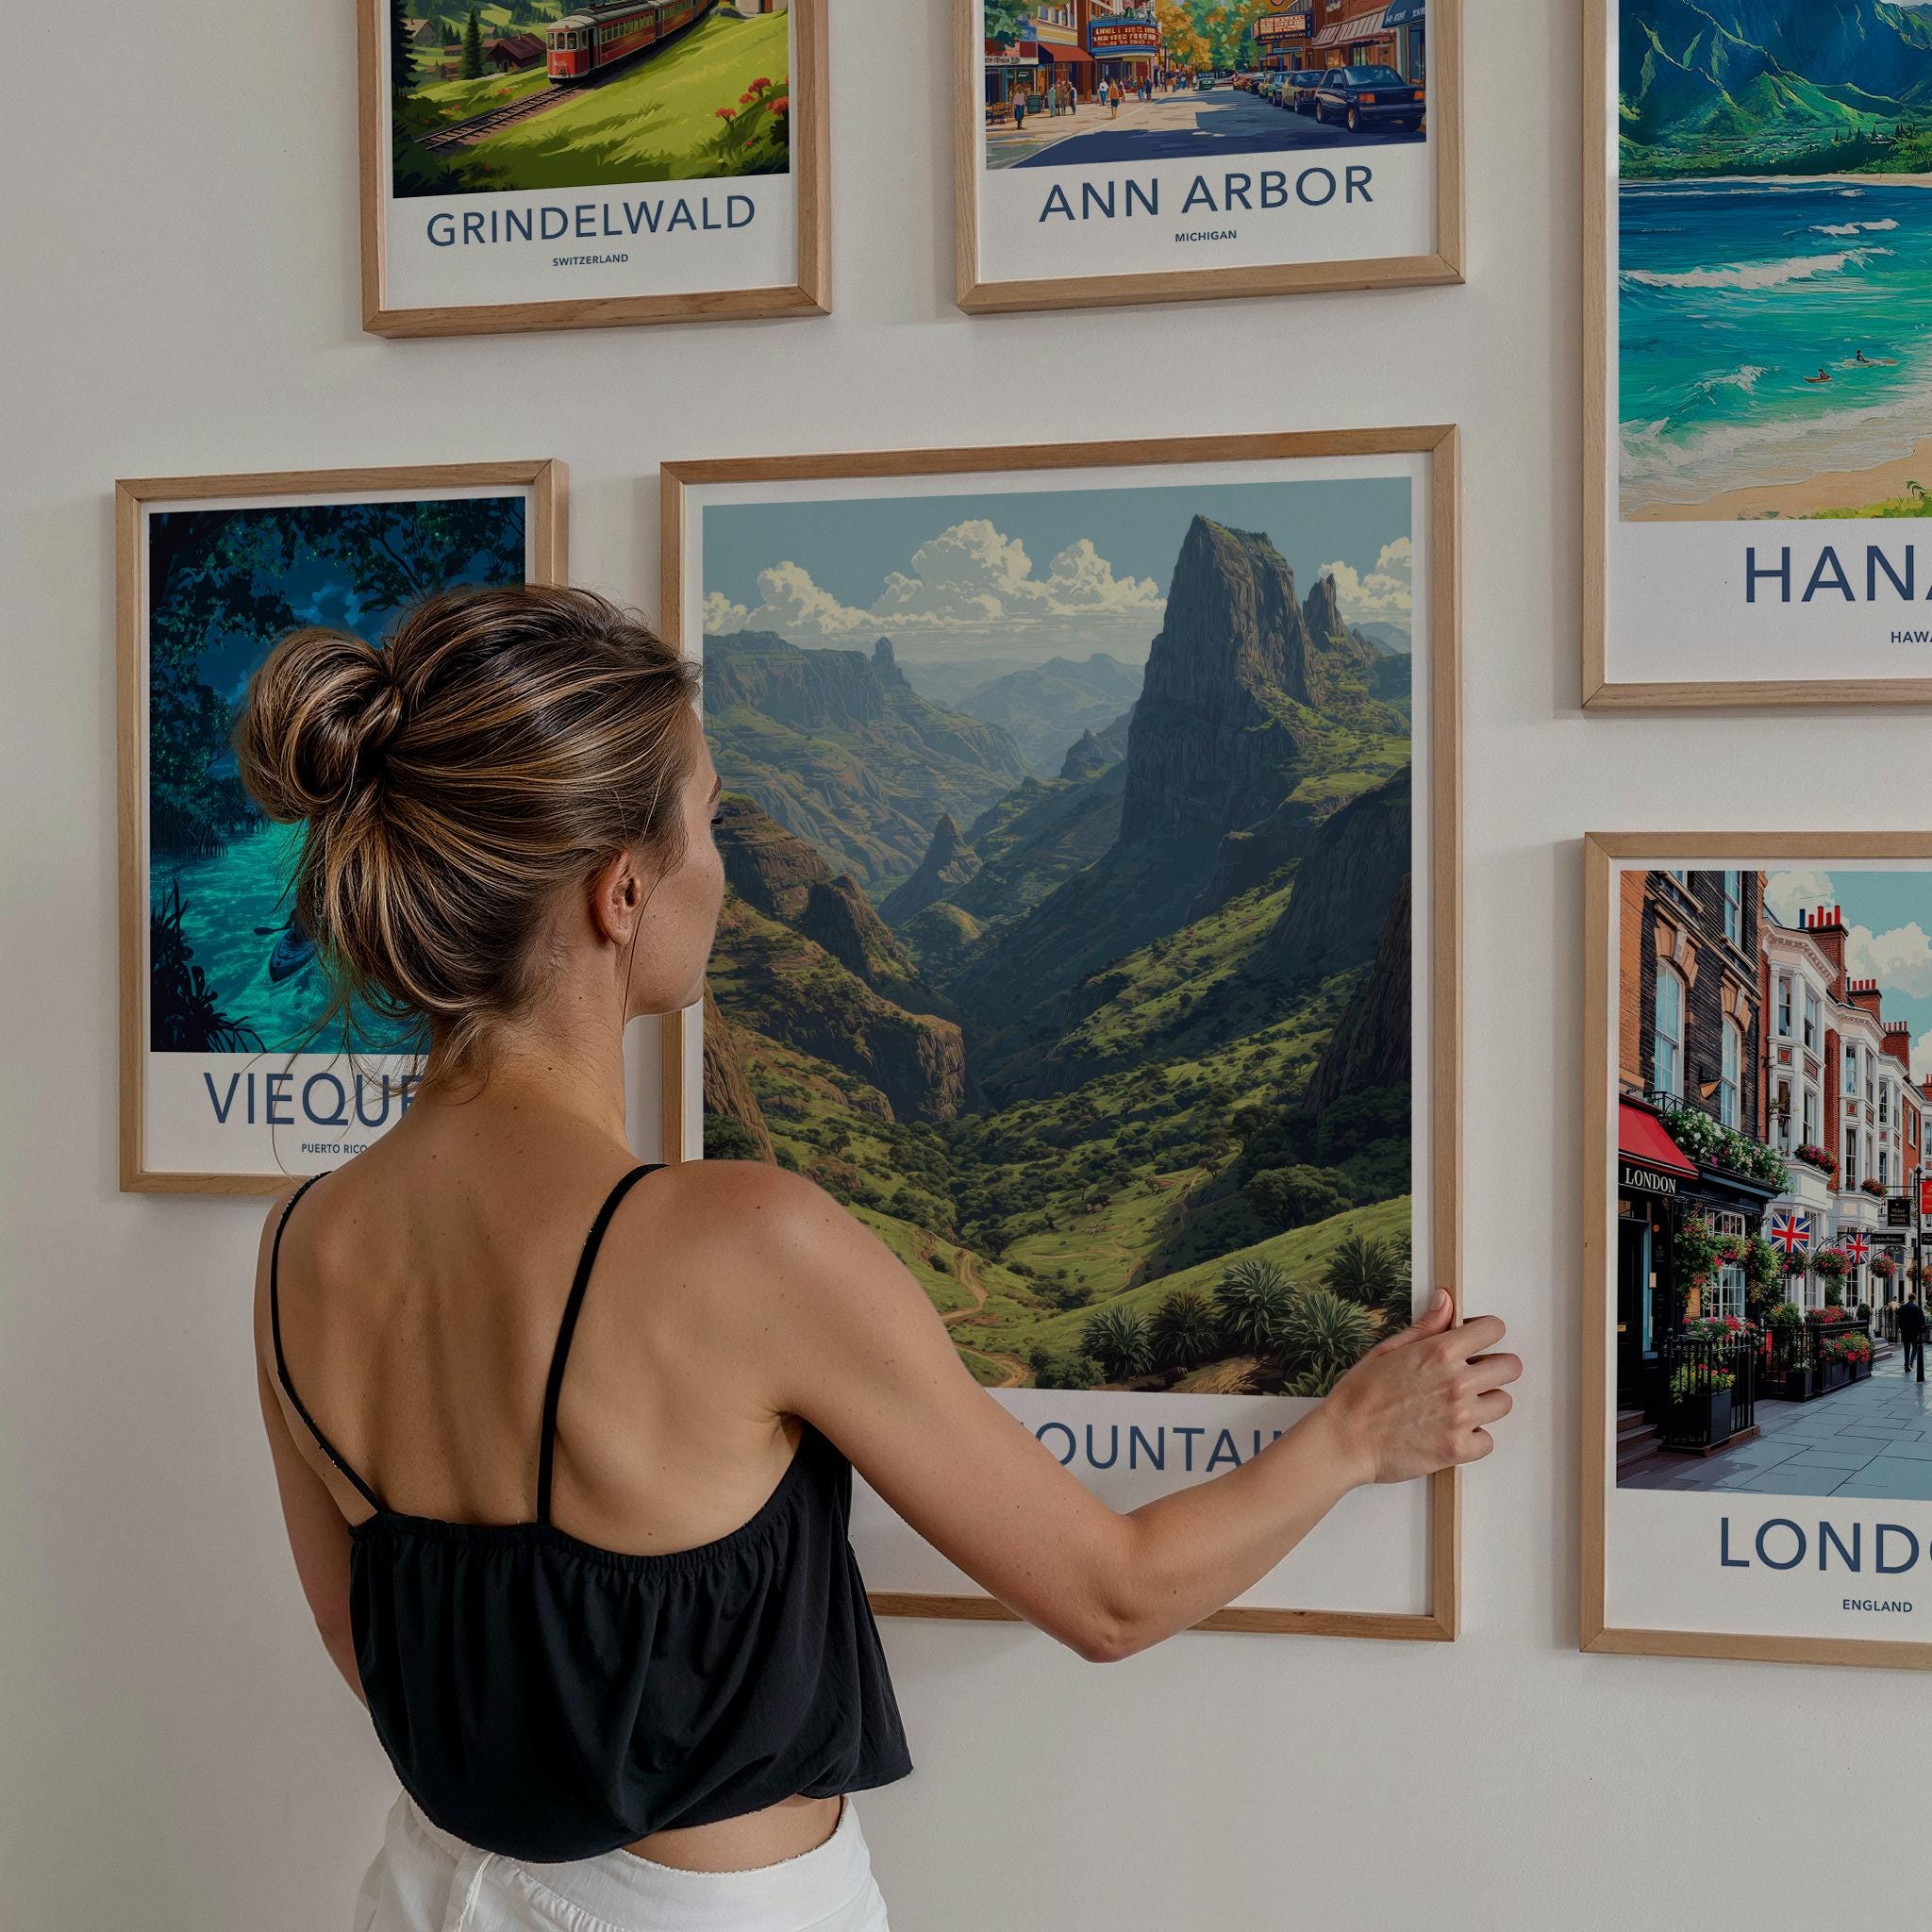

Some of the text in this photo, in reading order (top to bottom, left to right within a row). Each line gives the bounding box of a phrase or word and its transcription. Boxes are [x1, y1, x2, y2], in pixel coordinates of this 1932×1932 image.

[1039, 165, 1374, 223] ANN ARBOR
[426, 194, 755, 247] GRINDELWALD
[1174, 229, 1238, 242] MICHIGAN
[552, 253, 629, 267] SWITZERLAND
[1745, 544, 1932, 603] HAN
[1890, 630, 1932, 643] HAW
[301, 1142, 368, 1155] PUERTO RICO
[1624, 1167, 1676, 1194] LONDON
[1721, 1517, 1932, 1574] LOND
[1842, 1599, 1913, 1613] ENGLAND
